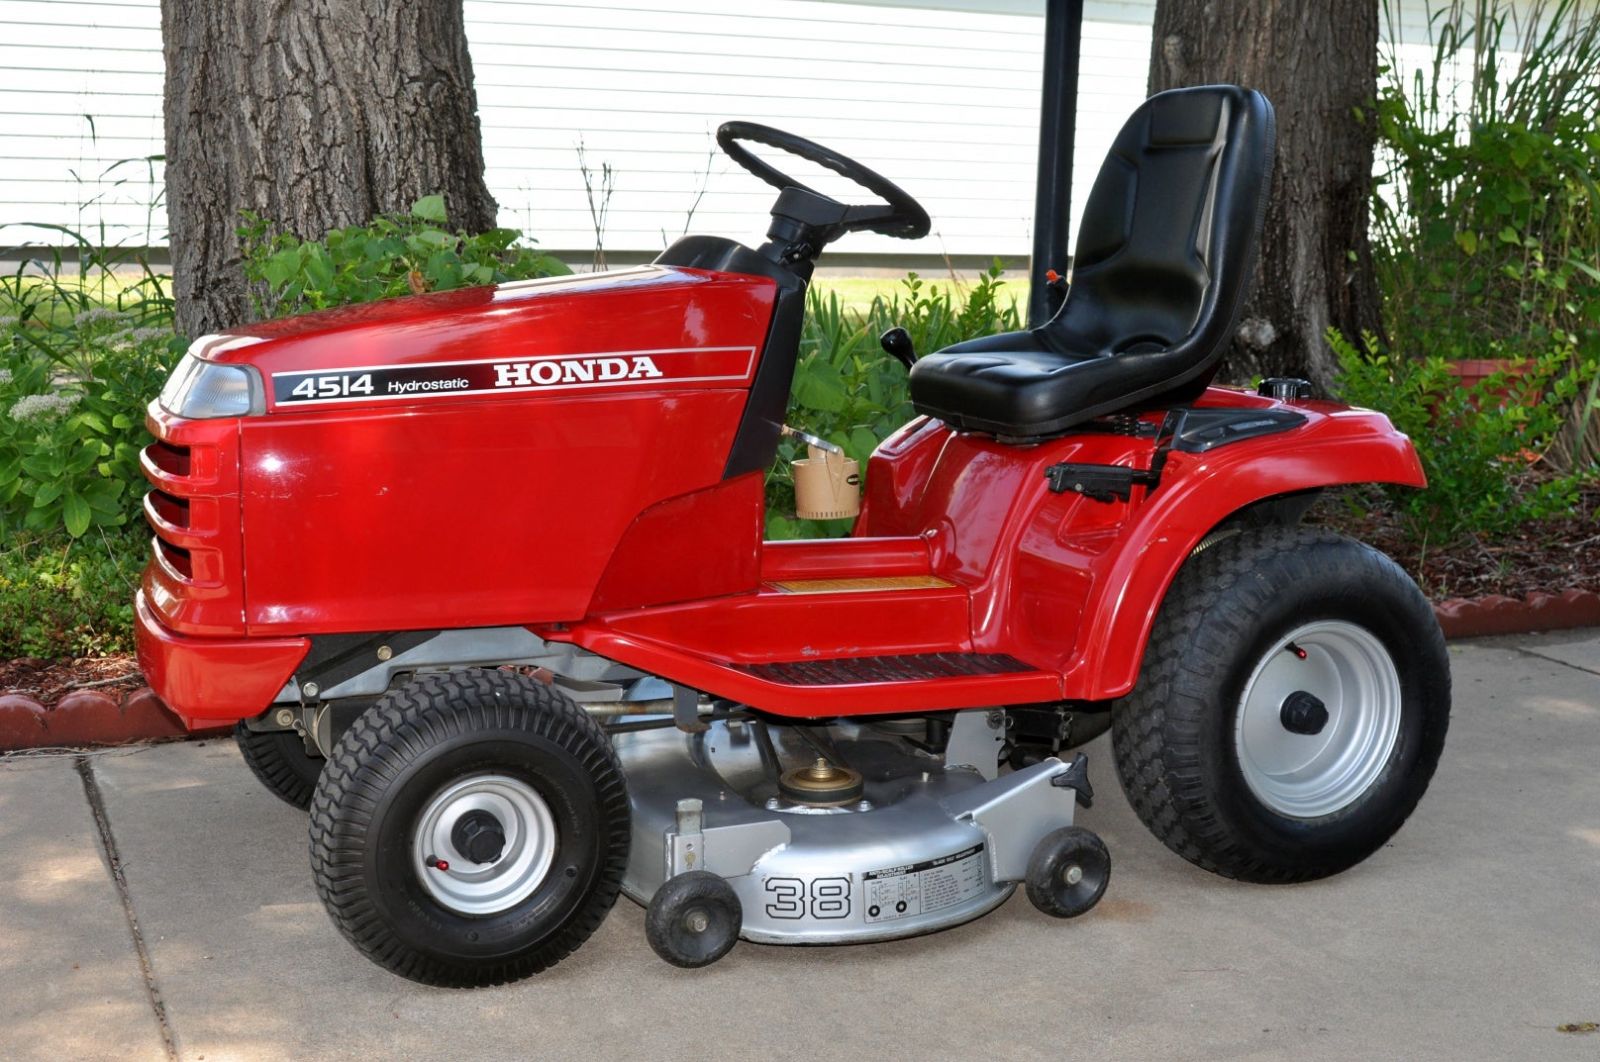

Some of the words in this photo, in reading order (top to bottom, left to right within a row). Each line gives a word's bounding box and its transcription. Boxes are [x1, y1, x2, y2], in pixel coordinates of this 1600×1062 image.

[292, 374, 374, 398] 4514
[388, 378, 469, 394] Hydrostatic
[493, 356, 663, 386] HONDA
[765, 877, 851, 919] 38
